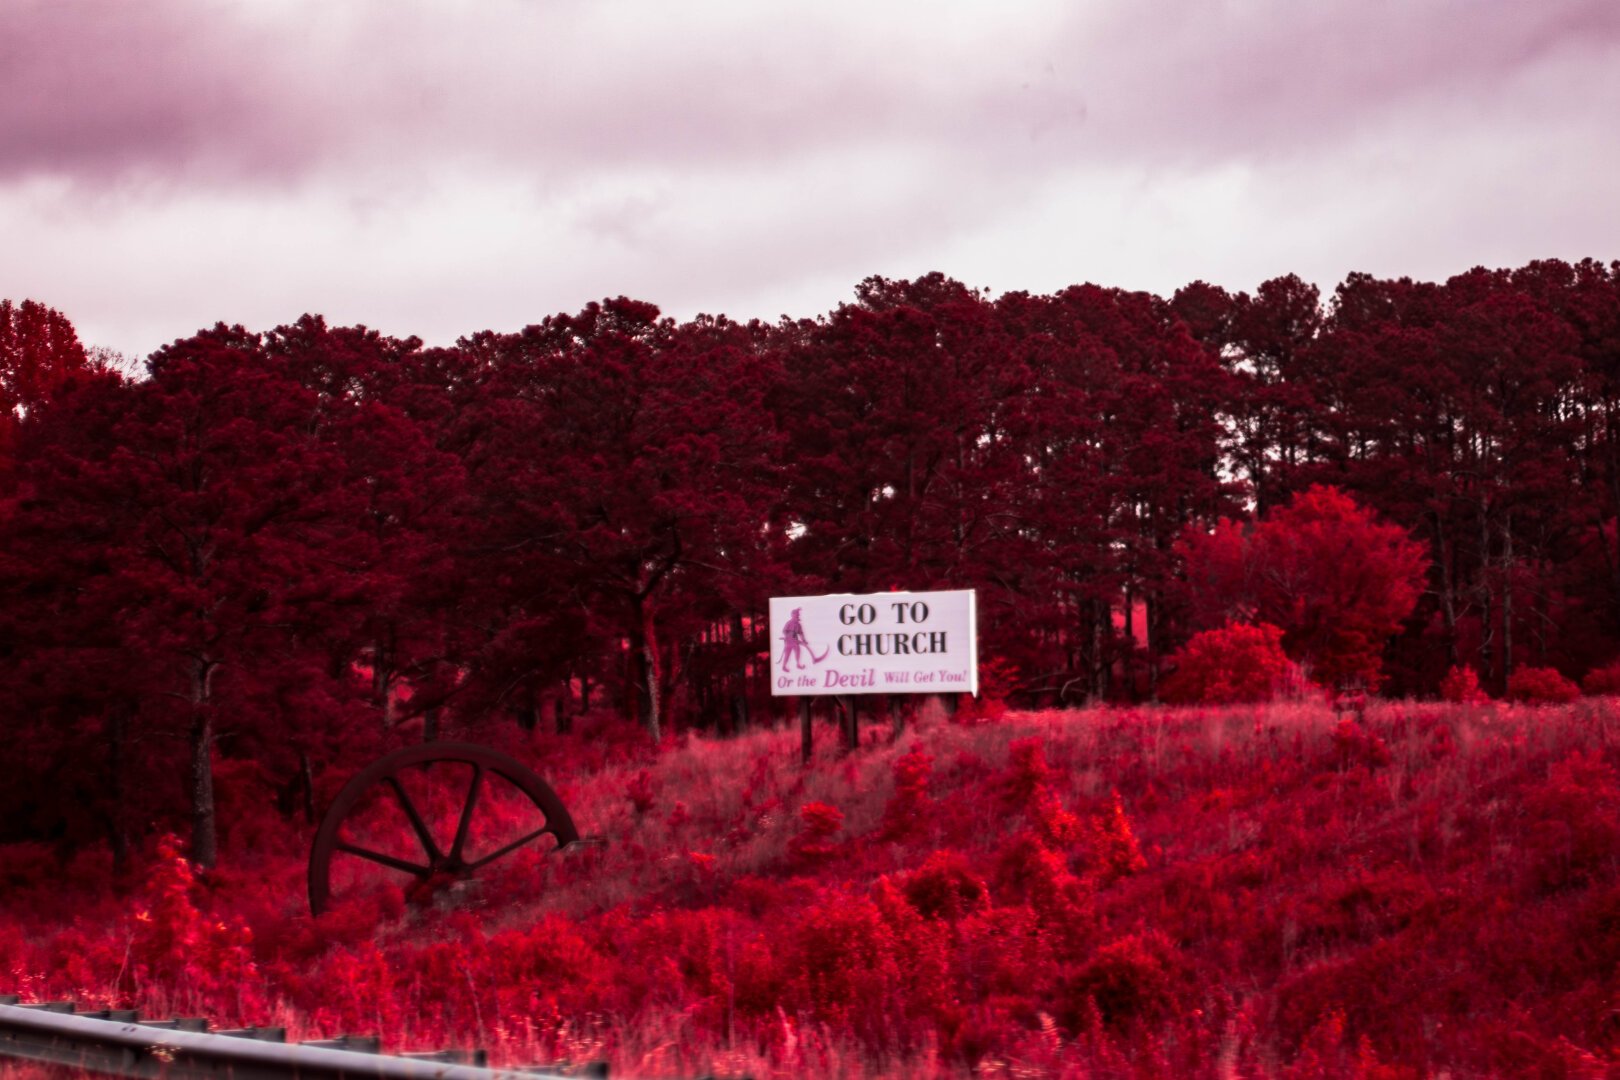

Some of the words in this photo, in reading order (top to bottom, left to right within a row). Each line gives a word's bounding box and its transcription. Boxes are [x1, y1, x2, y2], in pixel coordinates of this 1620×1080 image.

[839, 603, 876, 625] GO
[891, 601, 929, 624] TO
[837, 631, 948, 656] CHURCH
[777, 676, 794, 689] Or
[797, 674, 817, 688] the
[824, 668, 875, 688] Devil
[884, 671, 909, 684] Will
[914, 671, 934, 684] Get
[939, 670, 969, 683] You!
